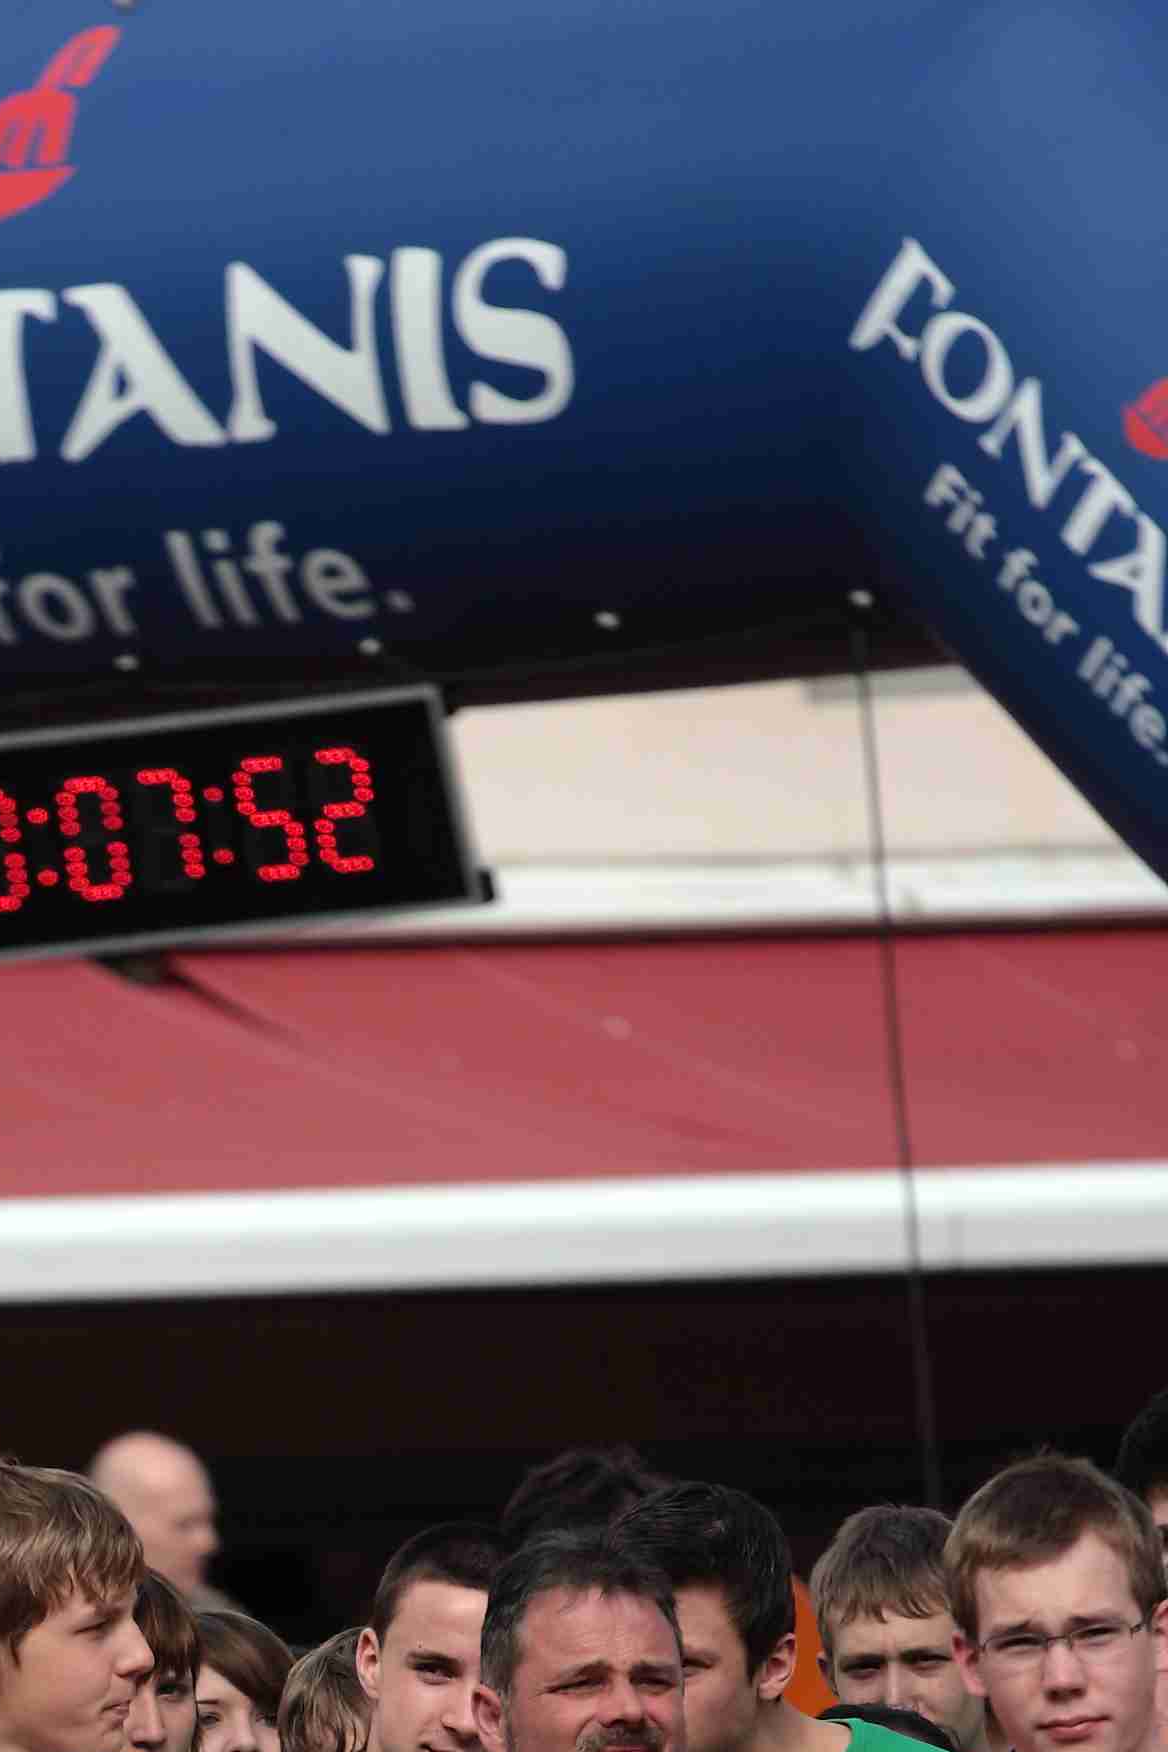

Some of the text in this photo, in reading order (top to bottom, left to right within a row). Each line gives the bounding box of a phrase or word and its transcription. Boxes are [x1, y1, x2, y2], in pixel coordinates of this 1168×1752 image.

[165, 521, 414, 630] life.
[924, 463, 997, 559] Fit
[996, 548, 1082, 644] for
